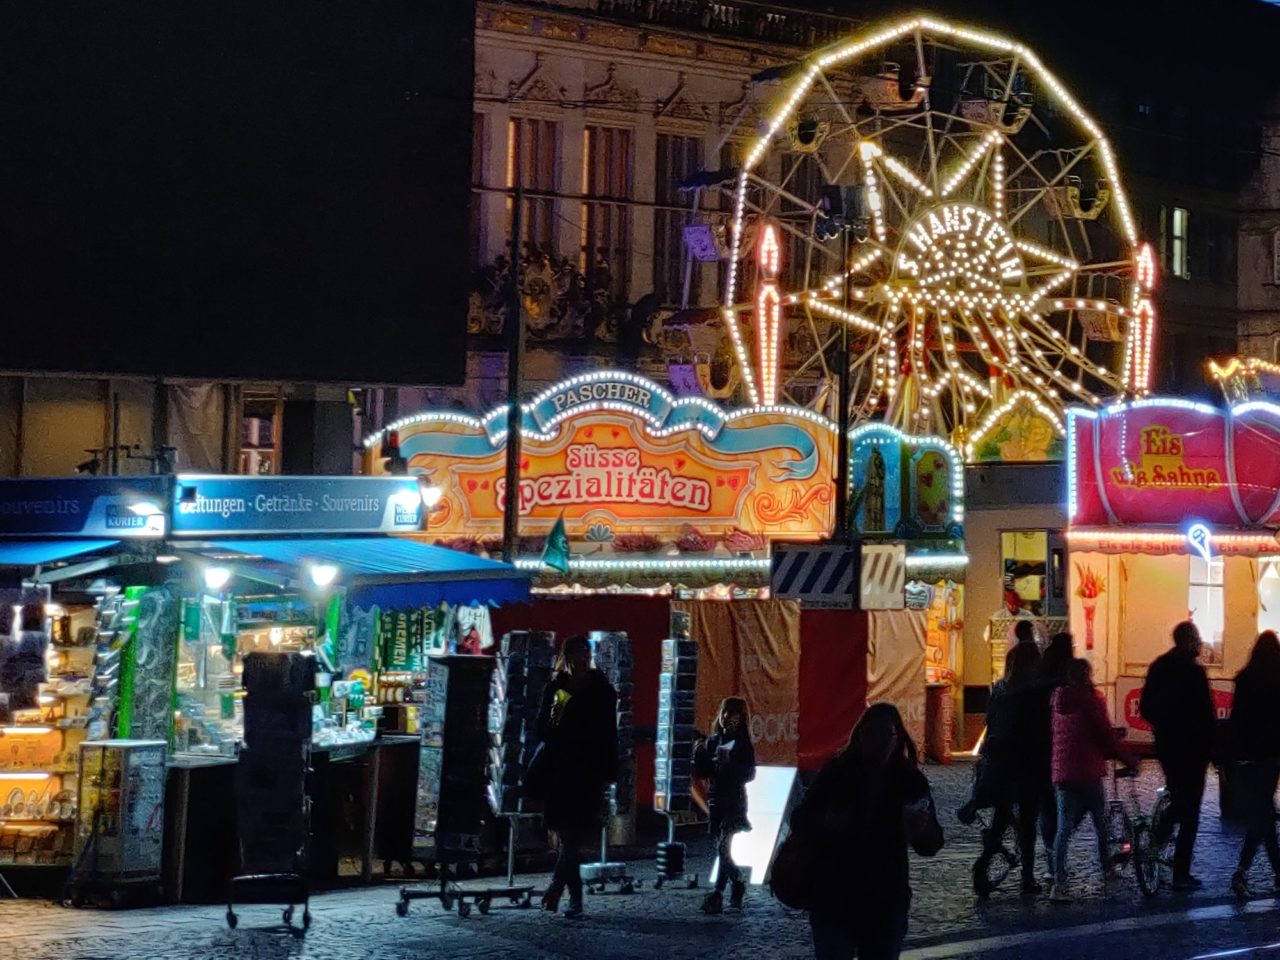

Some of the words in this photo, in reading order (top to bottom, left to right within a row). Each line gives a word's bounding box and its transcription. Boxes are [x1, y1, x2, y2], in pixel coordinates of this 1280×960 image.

[908, 205, 1023, 279] HANSTEIN
[551, 382, 653, 413] PASCHER
[1144, 428, 1181, 456] Eis
[568, 444, 639, 470] Süsse
[1152, 464, 1218, 488] Sahne
[0, 496, 81, 514] ouvenirs
[254, 494, 313, 513] Getränke
[321, 494, 380, 512] Souvenirs
[108, 516, 144, 527] KURIER
